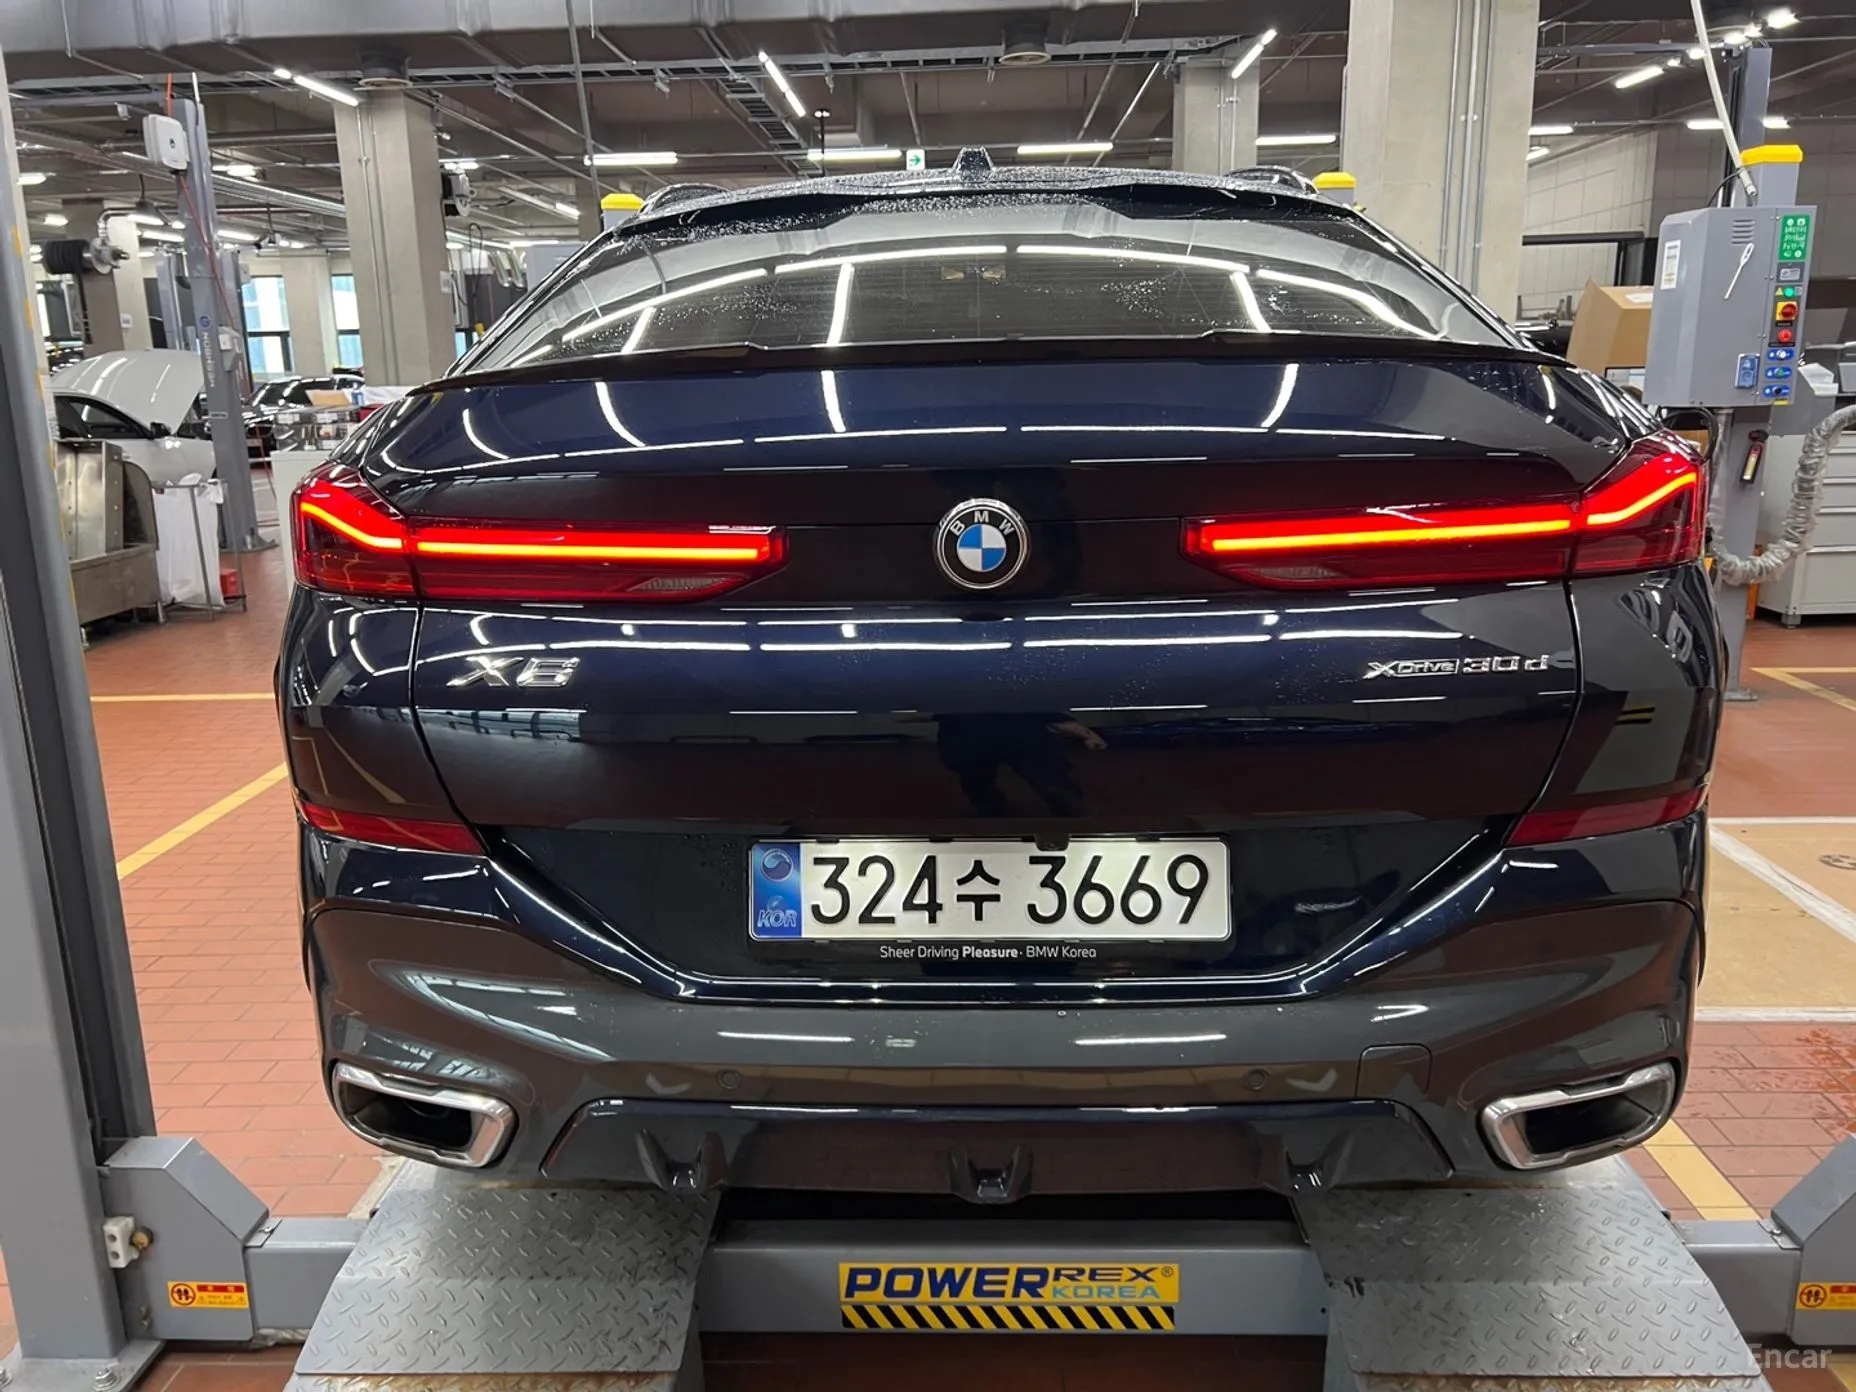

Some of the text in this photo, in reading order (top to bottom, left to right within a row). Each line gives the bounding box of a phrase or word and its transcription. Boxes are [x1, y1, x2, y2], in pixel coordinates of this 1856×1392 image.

[950, 511, 1015, 536] BMW
[446, 656, 581, 687] X6
[1027, 854, 1209, 925] 3669
[757, 908, 797, 928] KOR
[880, 945, 915, 959] Sheer
[918, 945, 959, 961] Driving
[1026, 945, 1060, 959] BMW
[1062, 945, 1097, 959] Korea
[1052, 1285, 1161, 1299] KOREA
